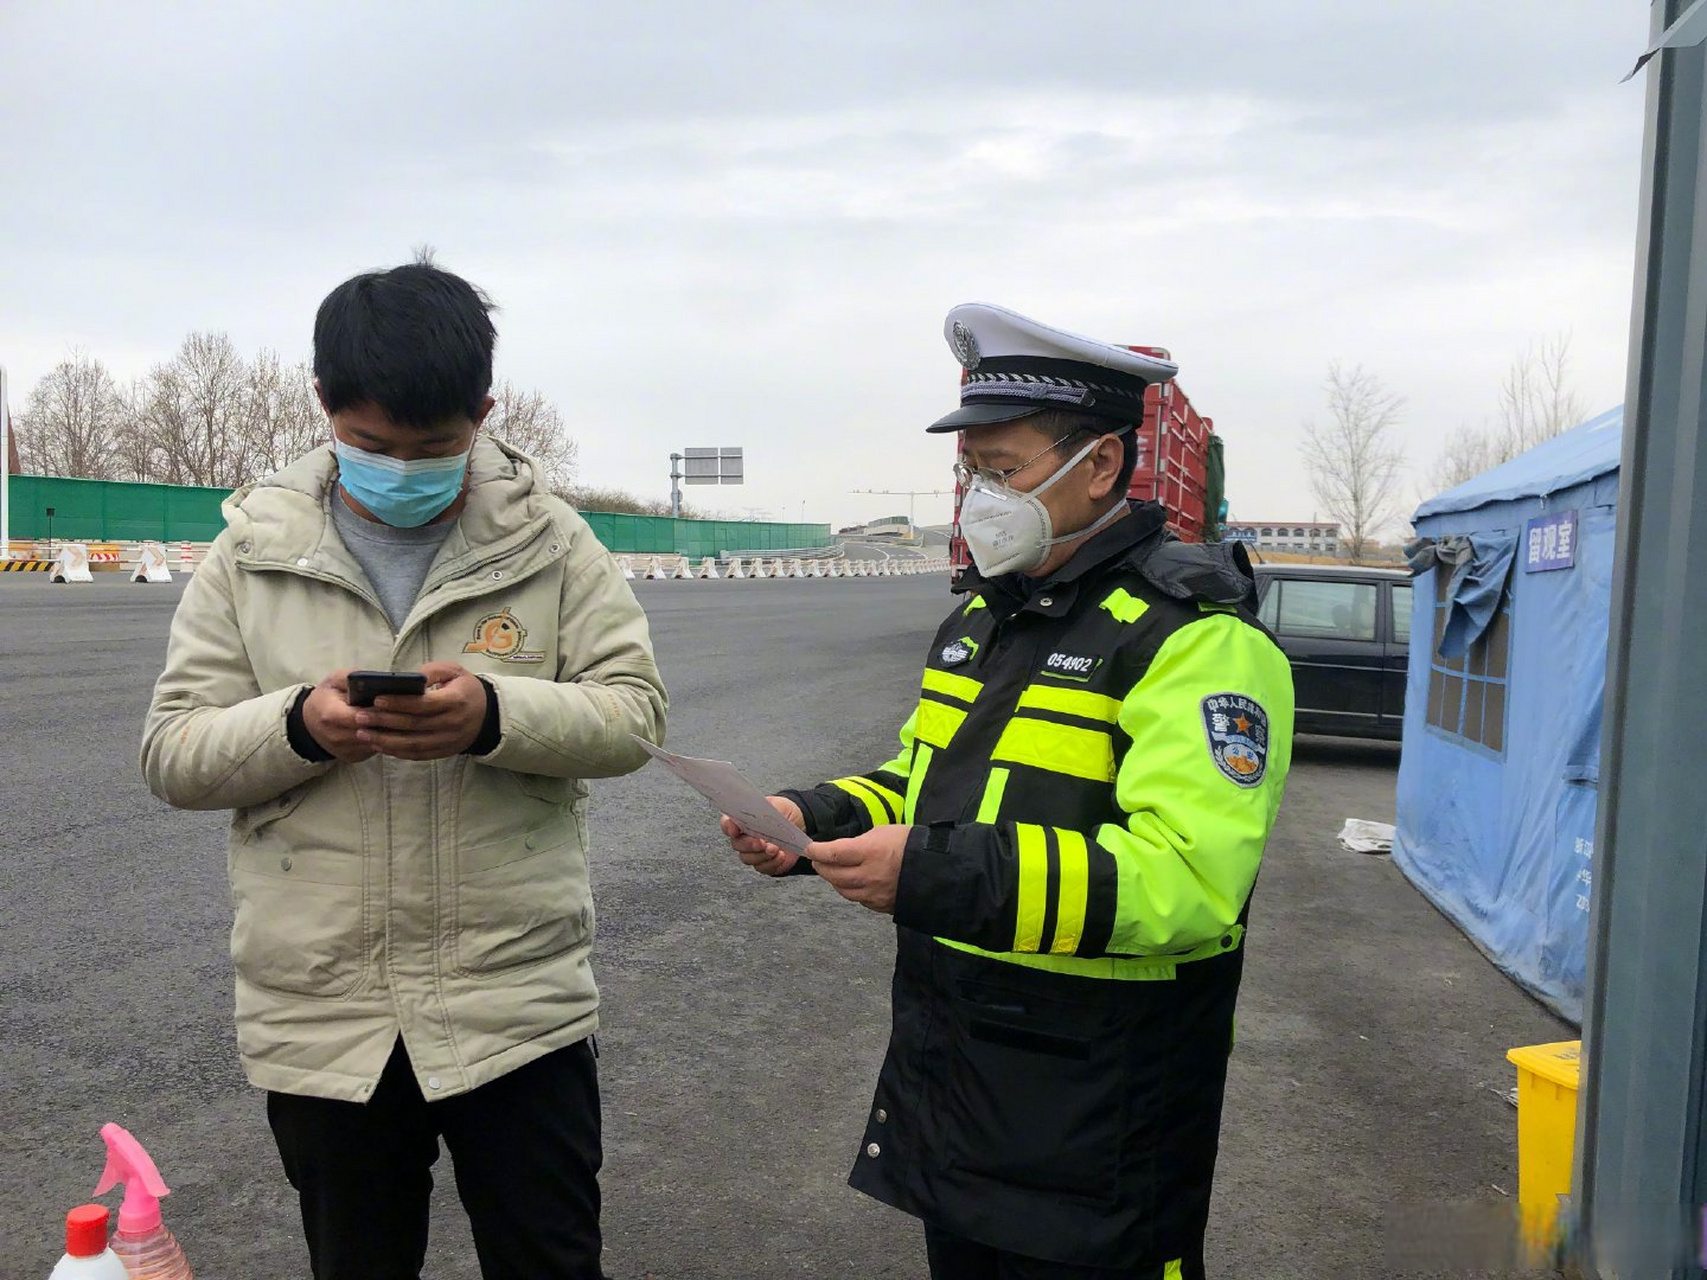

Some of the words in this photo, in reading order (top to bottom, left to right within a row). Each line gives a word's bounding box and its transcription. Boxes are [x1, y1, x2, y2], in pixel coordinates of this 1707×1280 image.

[1529, 520, 1573, 564] 留观室
[1047, 653, 1093, 672] 054902
